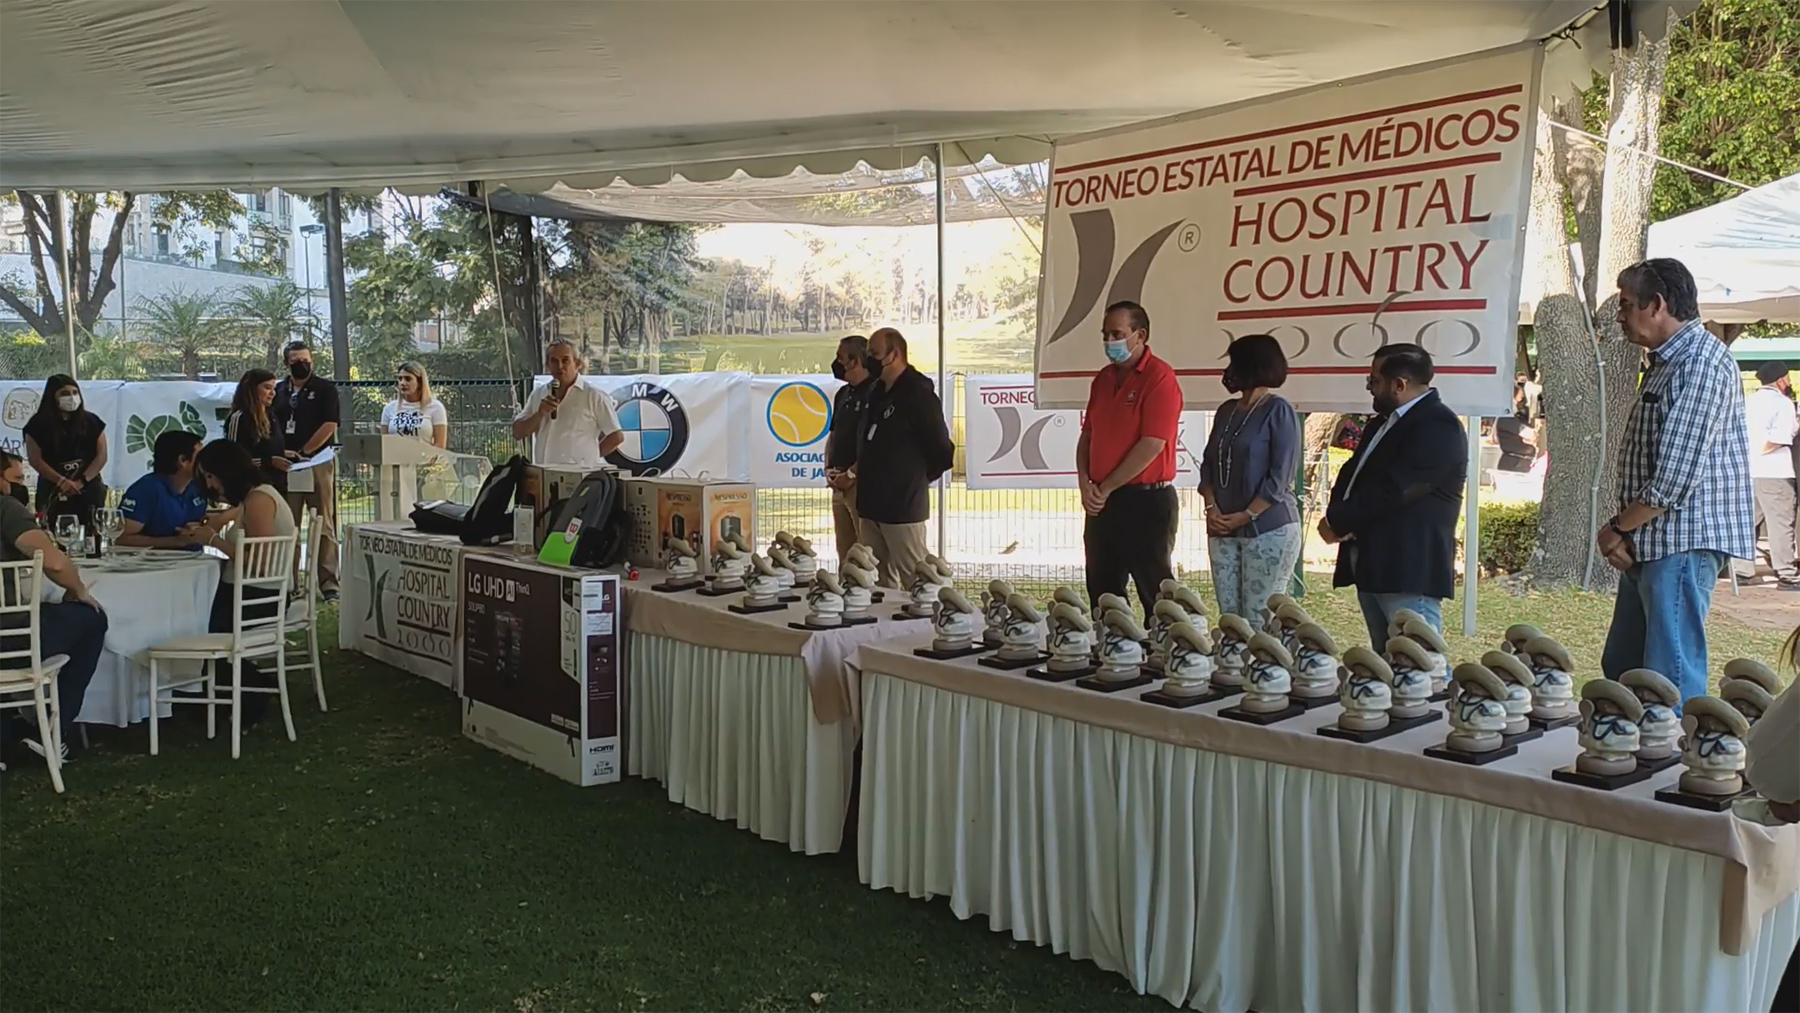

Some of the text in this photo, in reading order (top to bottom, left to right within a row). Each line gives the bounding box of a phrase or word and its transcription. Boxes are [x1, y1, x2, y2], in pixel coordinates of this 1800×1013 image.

[1053, 103, 1523, 209] TORNEO ESTATAL DE MÉDICOS
[1229, 174, 1493, 248] HOSPITAL
[1222, 238, 1491, 304] COUNTRY
[791, 467, 807, 478] DE
[714, 492, 748, 501] NESPRESSO
[397, 568, 451, 599] HOSPITAL
[468, 571, 481, 594] LG
[484, 575, 504, 599] UHD
[397, 595, 451, 628] COUNTRY
[563, 610, 577, 636] 50
[589, 744, 615, 755] HDMI
